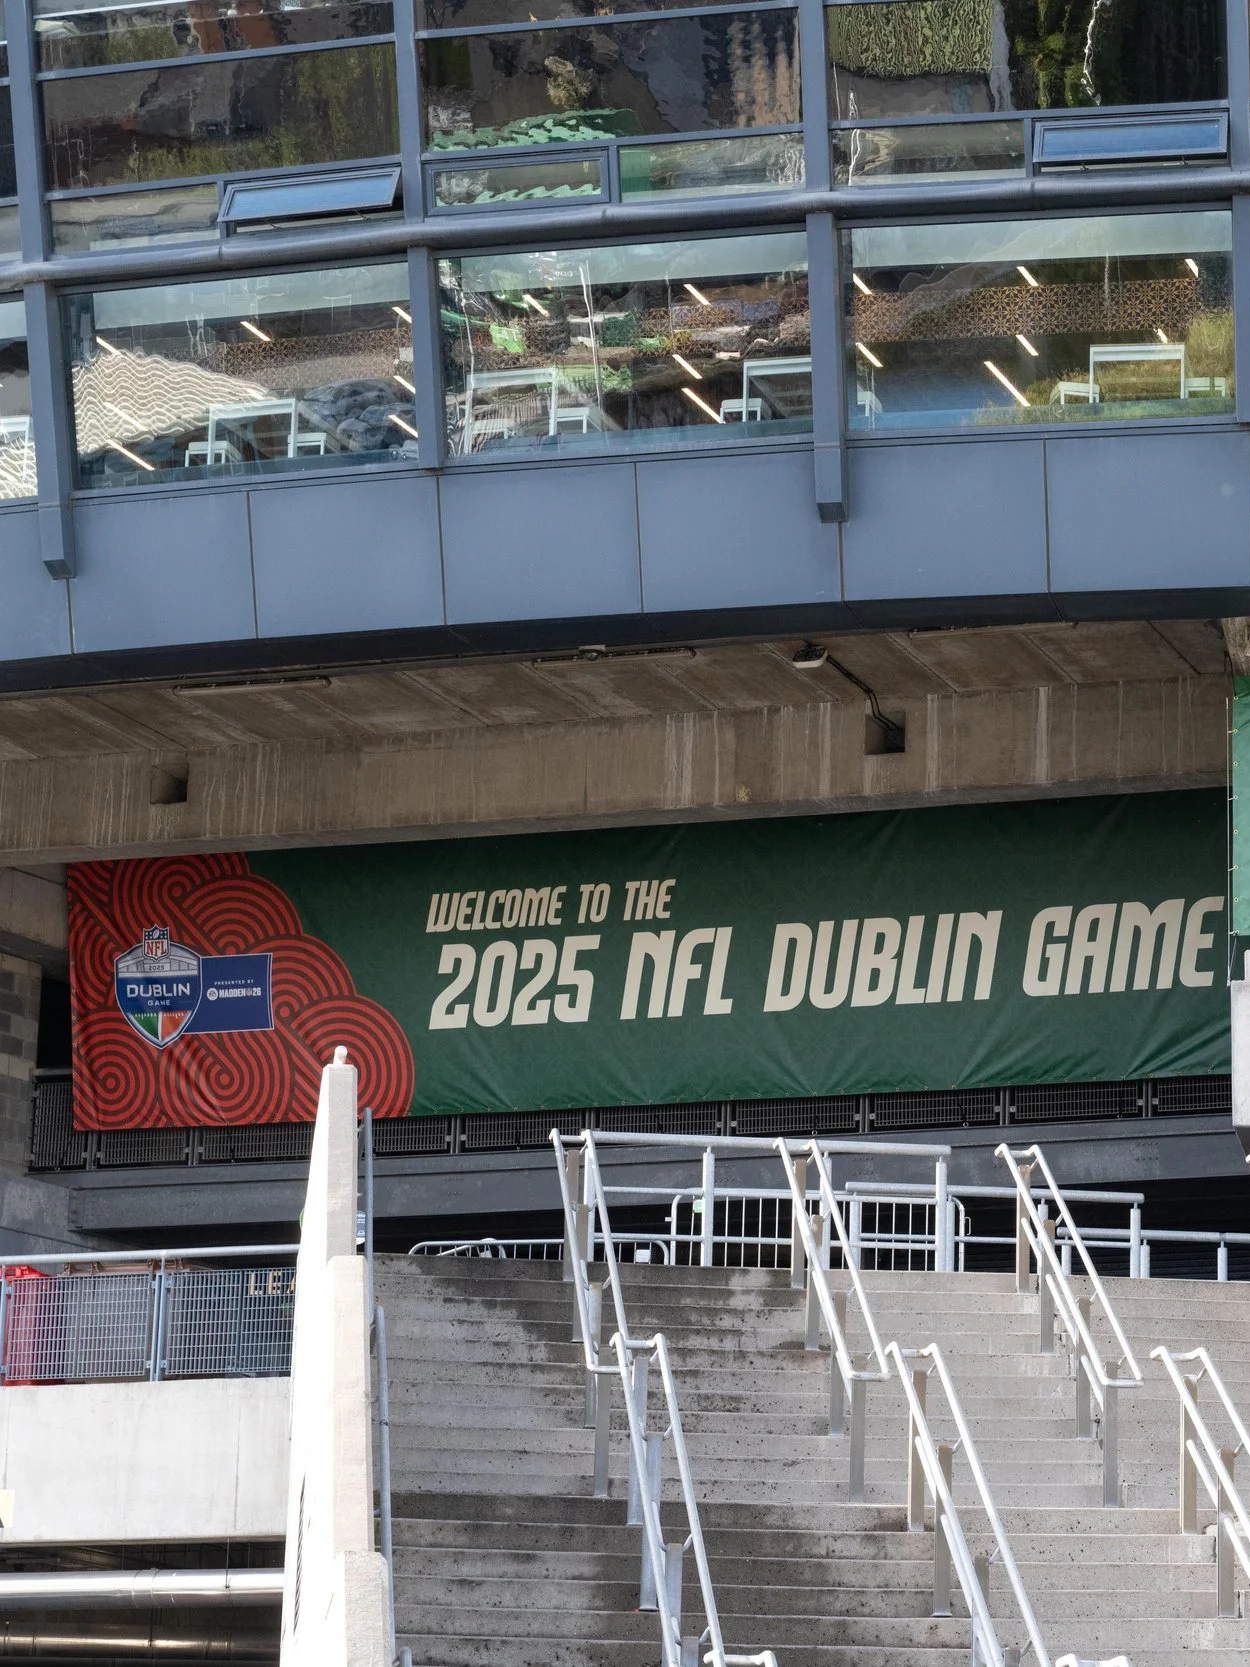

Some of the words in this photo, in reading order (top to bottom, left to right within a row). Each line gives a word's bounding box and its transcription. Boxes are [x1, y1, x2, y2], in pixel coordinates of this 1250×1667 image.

[425, 885, 567, 933] WELCOME
[577, 883, 611, 924] TO
[623, 878, 676, 921] THE
[146, 940, 167, 957] NFL
[428, 934, 601, 1030] 2025
[619, 926, 733, 1020] NFL
[763, 910, 1003, 1012] DUBLIN
[1022, 895, 1225, 997] GAME
[126, 983, 191, 997] DUBLIN
[219, 988, 246, 998] MADDEN
[252, 987, 261, 996] 26
